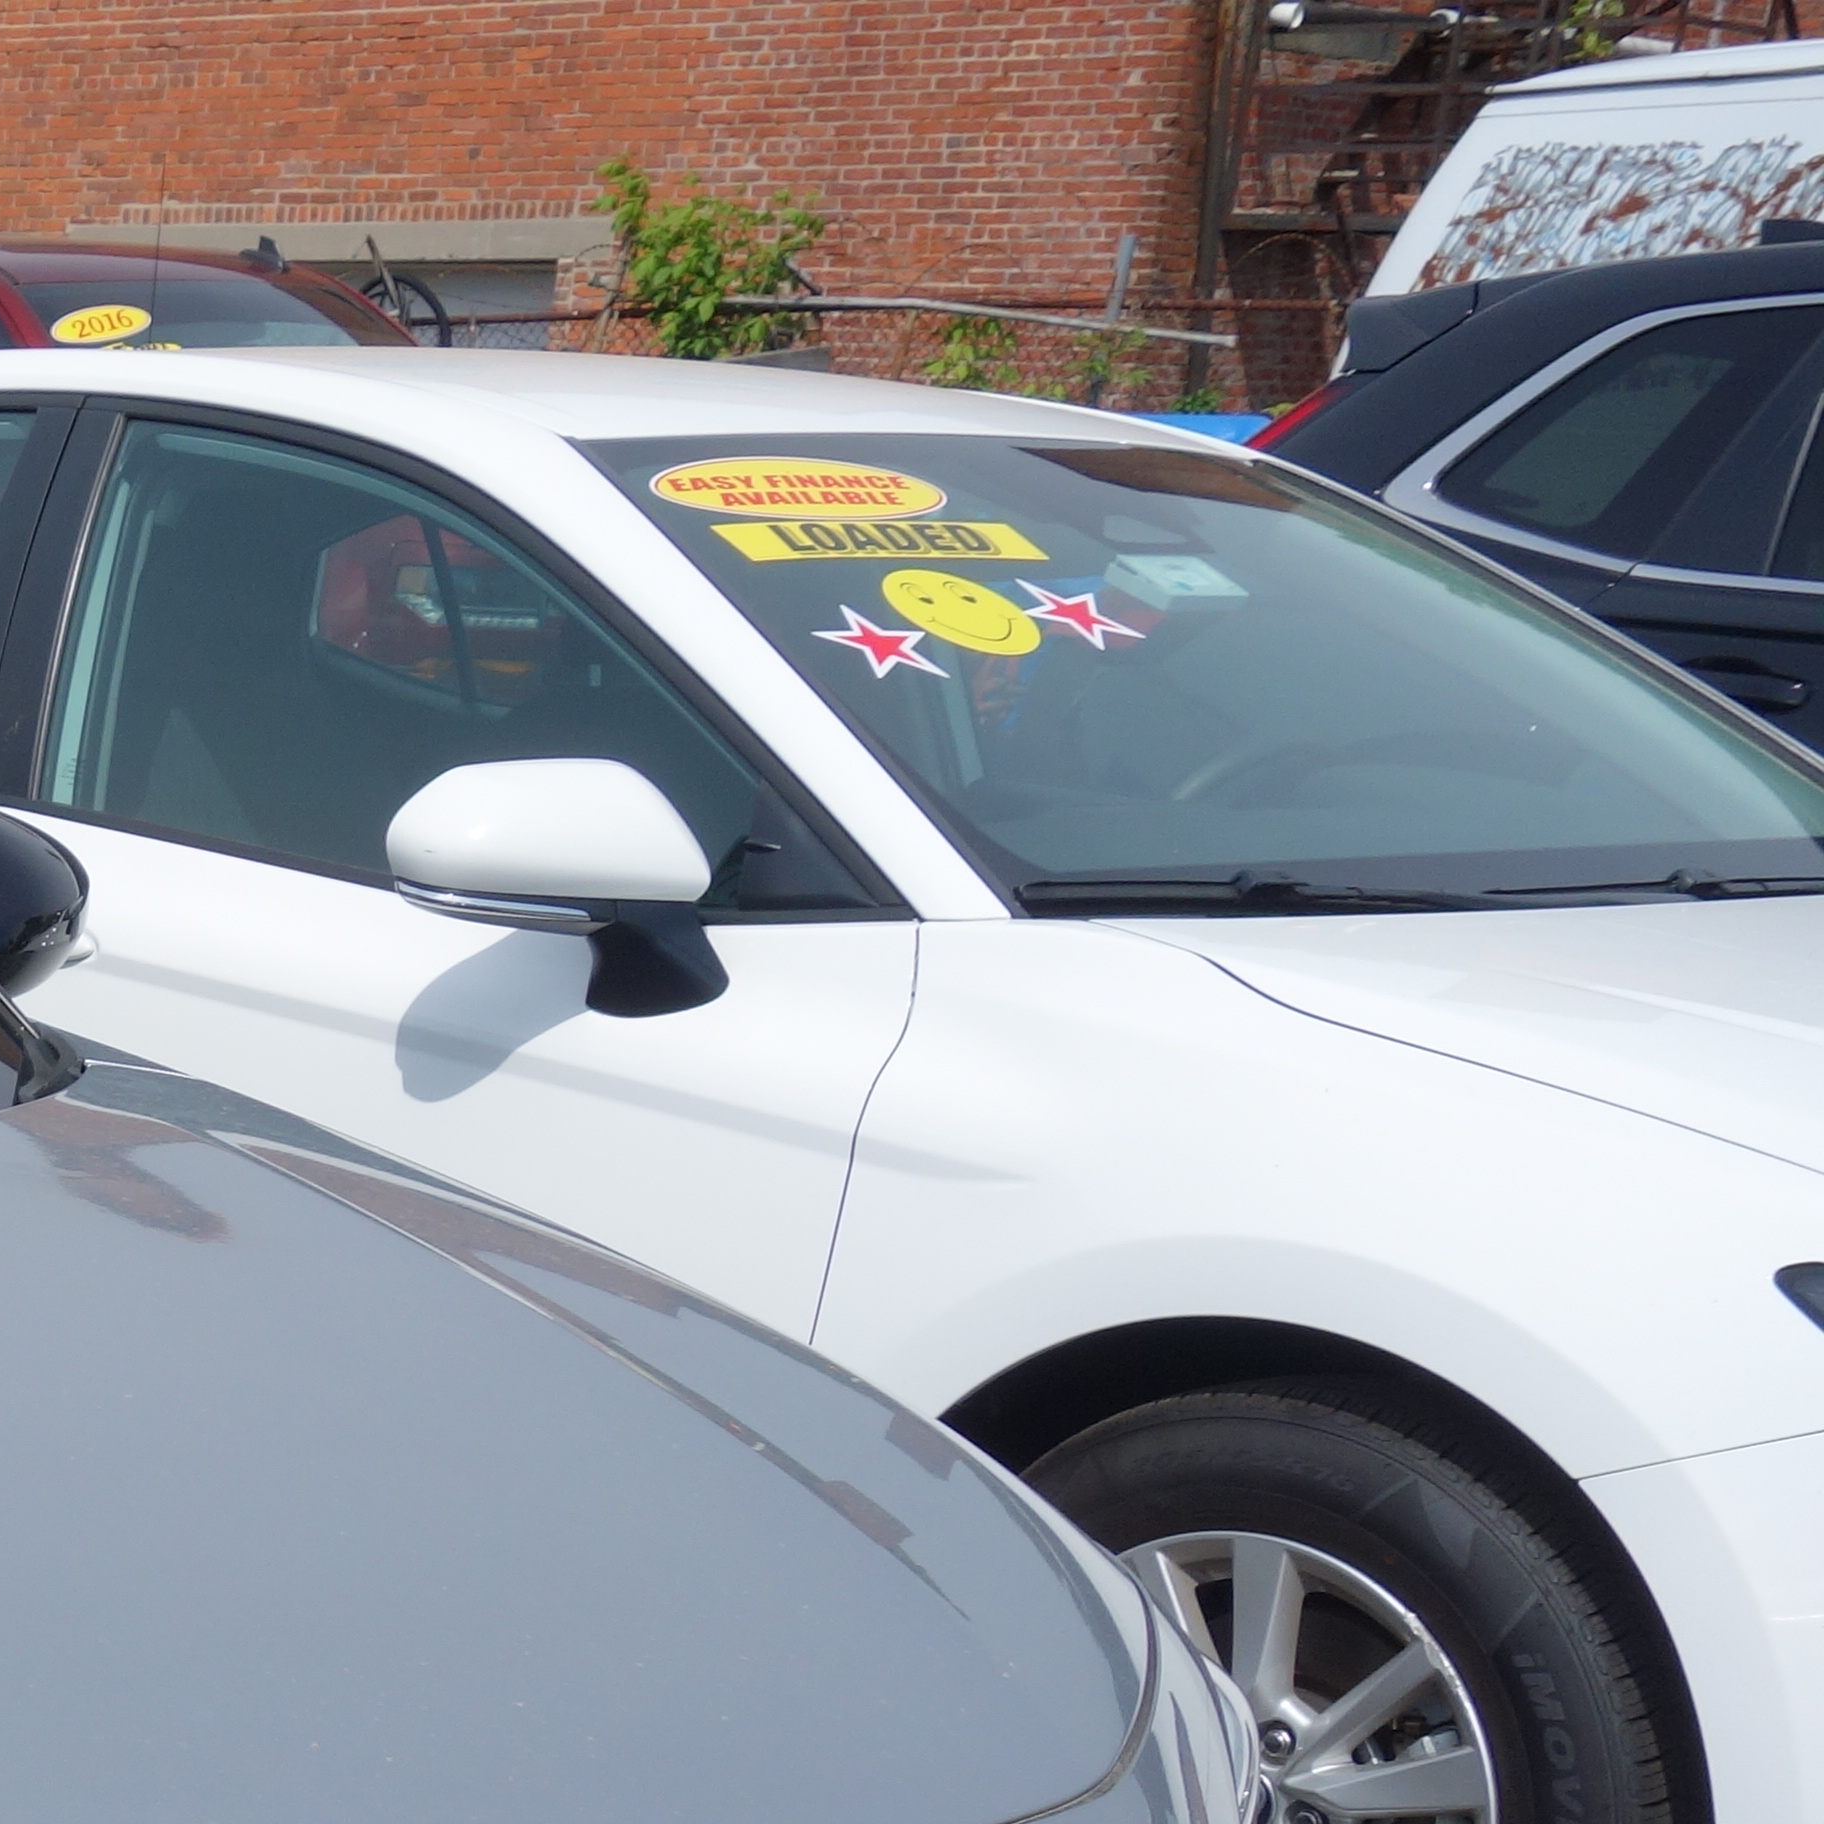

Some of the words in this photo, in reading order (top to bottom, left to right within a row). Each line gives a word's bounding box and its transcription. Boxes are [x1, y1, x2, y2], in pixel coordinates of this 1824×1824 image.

[72, 309, 134, 339] 2016
[668, 475, 755, 491] EASY
[763, 475, 910, 490] FINANCE
[720, 492, 905, 506] AVAILABLE
[768, 523, 1000, 555] LOADED
